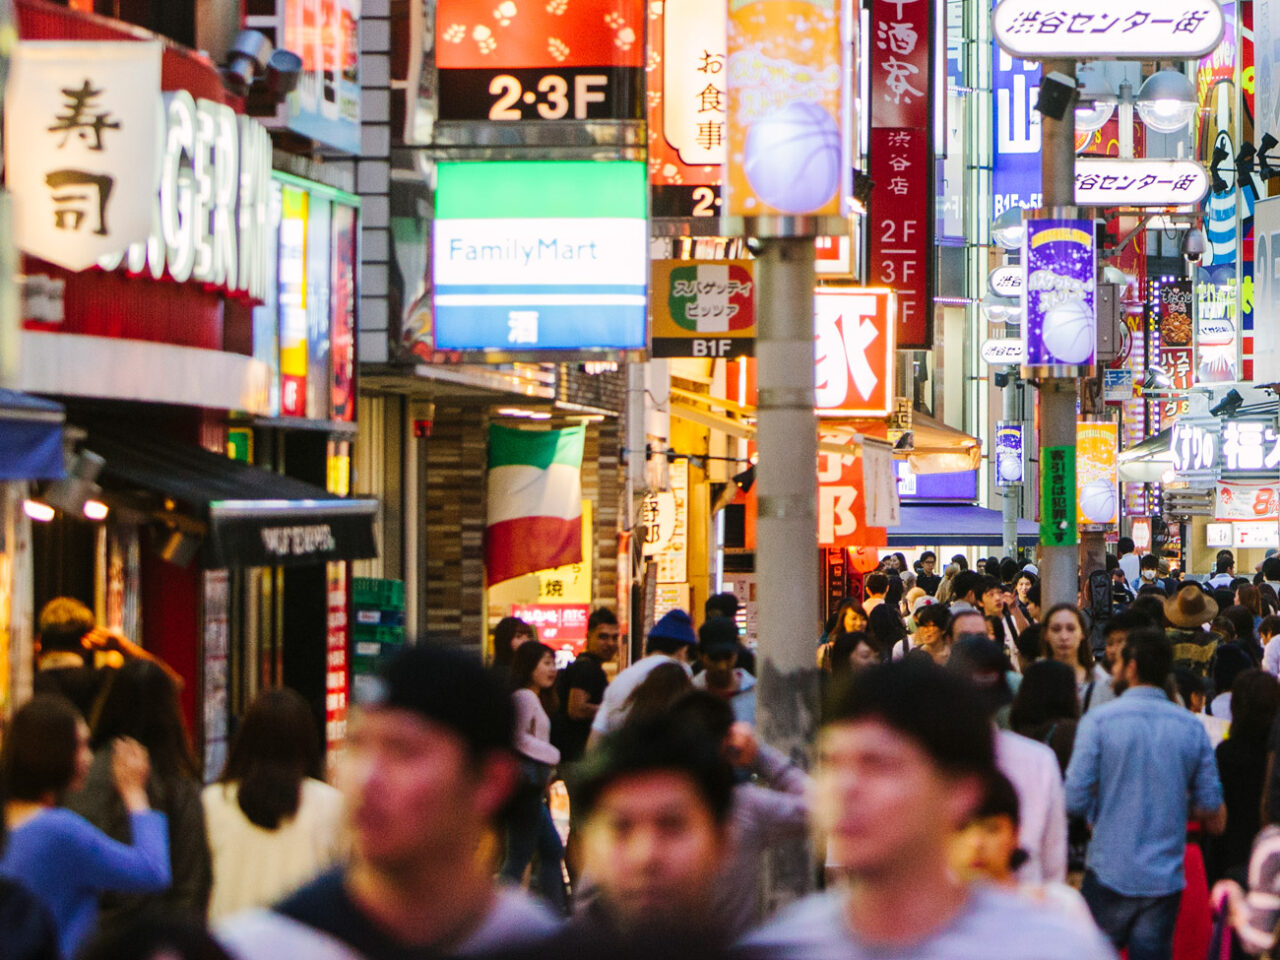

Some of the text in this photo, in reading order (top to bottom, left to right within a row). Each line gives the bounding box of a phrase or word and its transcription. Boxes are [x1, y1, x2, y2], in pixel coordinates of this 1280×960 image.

[1005, 9, 1211, 36] 渋谷センター街
[696, 48, 726, 151] お食事
[46, 78, 122, 235] 寿司
[887, 131, 912, 195] 渋谷店
[881, 219, 917, 242] 2F
[448, 238, 599, 265] FamilyMart
[880, 260, 917, 283] 3F
[508, 310, 539, 344] 酒
[692, 339, 732, 357] B1F
